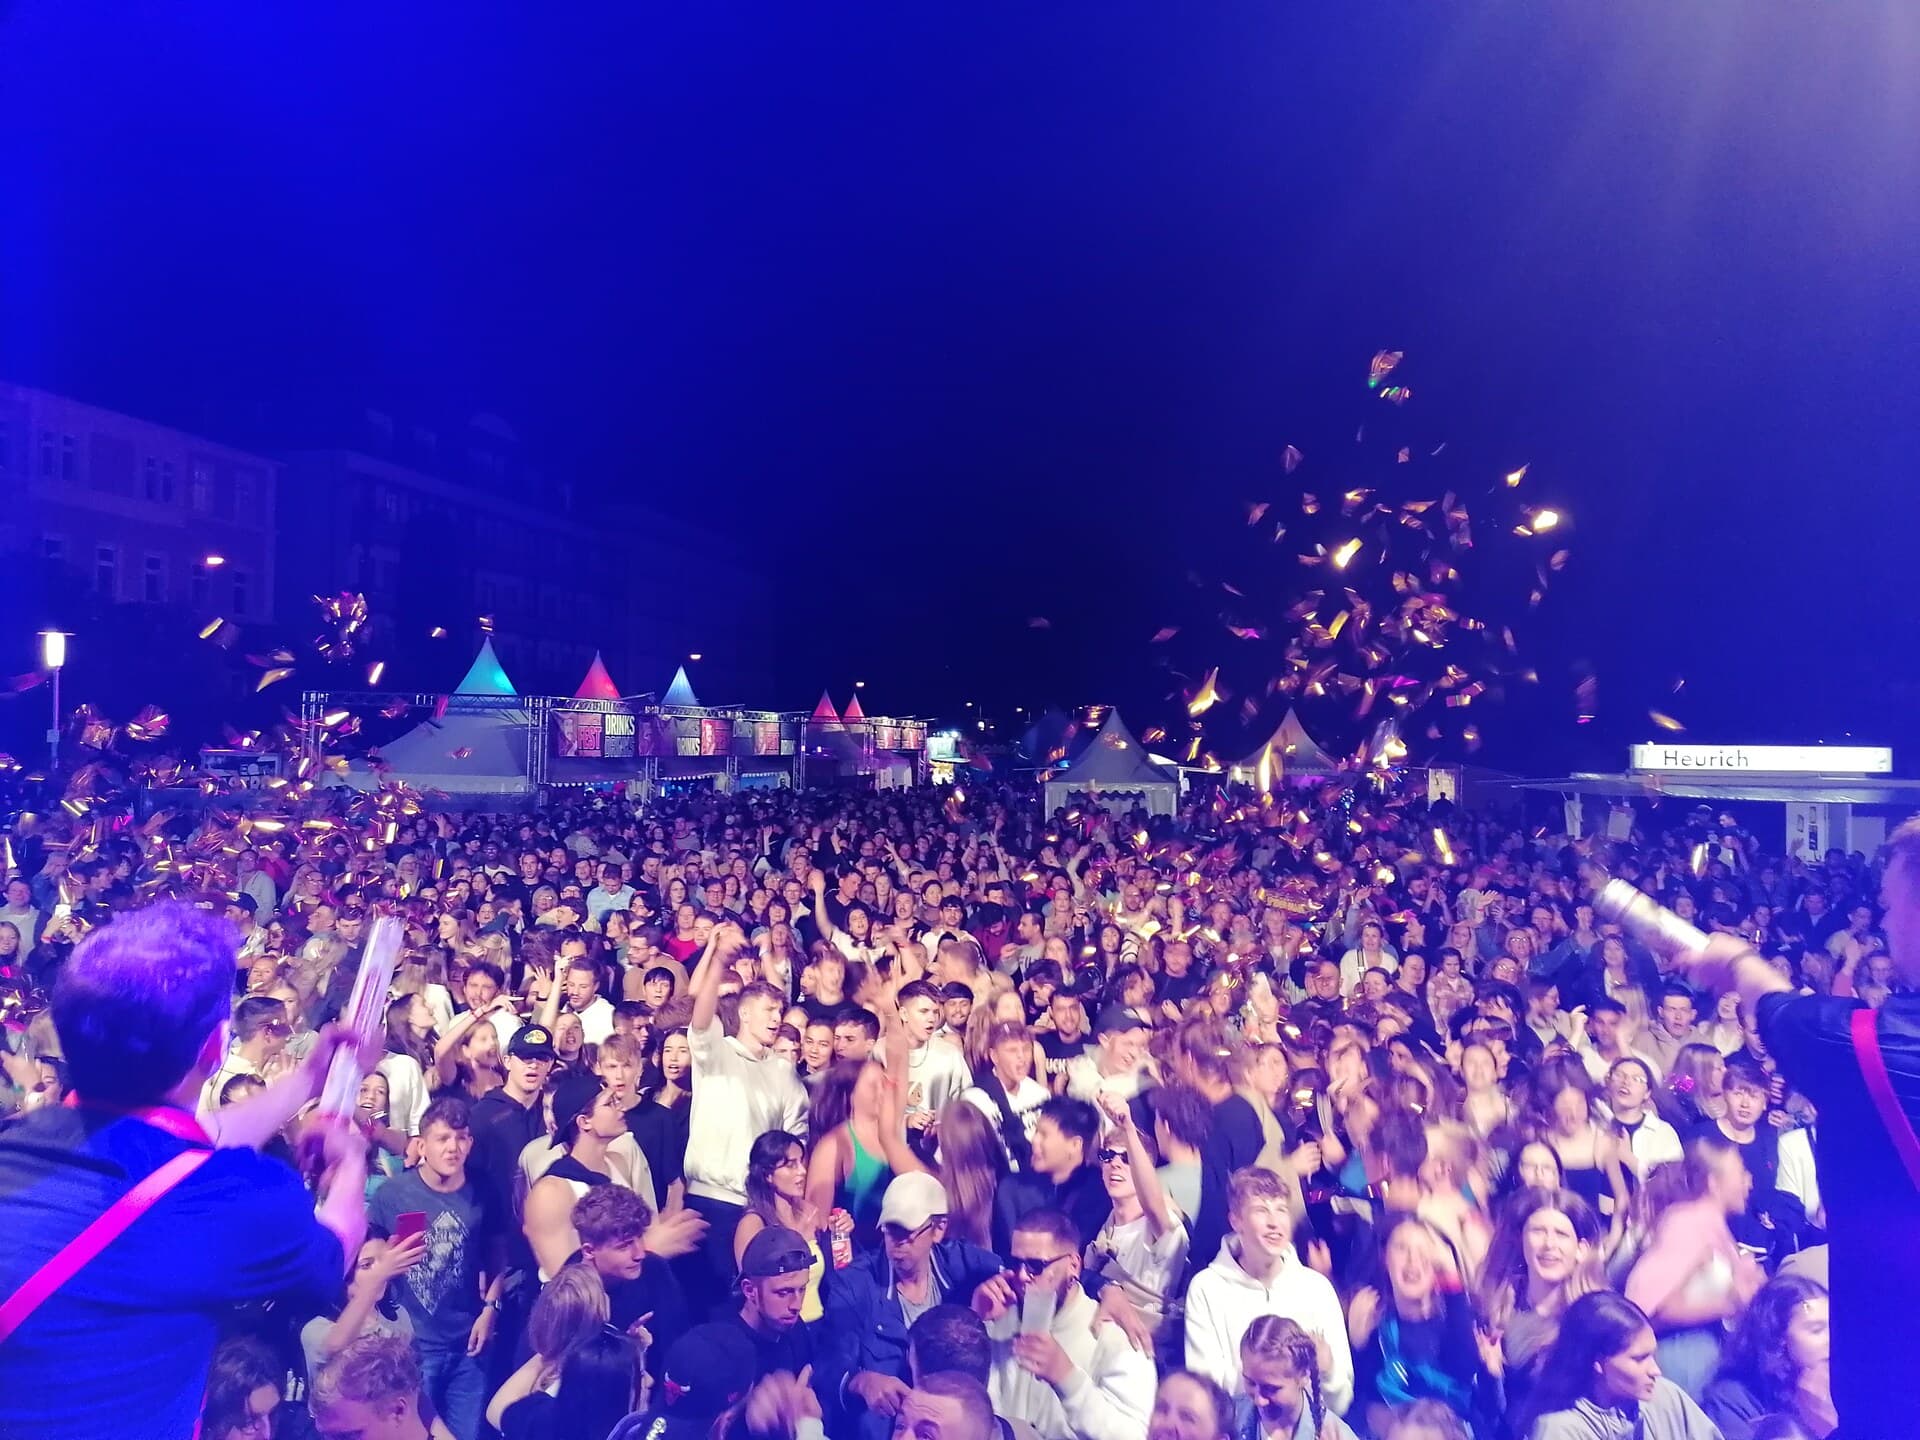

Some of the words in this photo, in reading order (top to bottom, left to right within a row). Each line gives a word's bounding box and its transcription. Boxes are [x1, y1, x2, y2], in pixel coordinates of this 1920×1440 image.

[604, 713, 636, 736] DRINKS
[578, 726, 602, 750] FEST
[1663, 749, 1750, 768] Heurich
